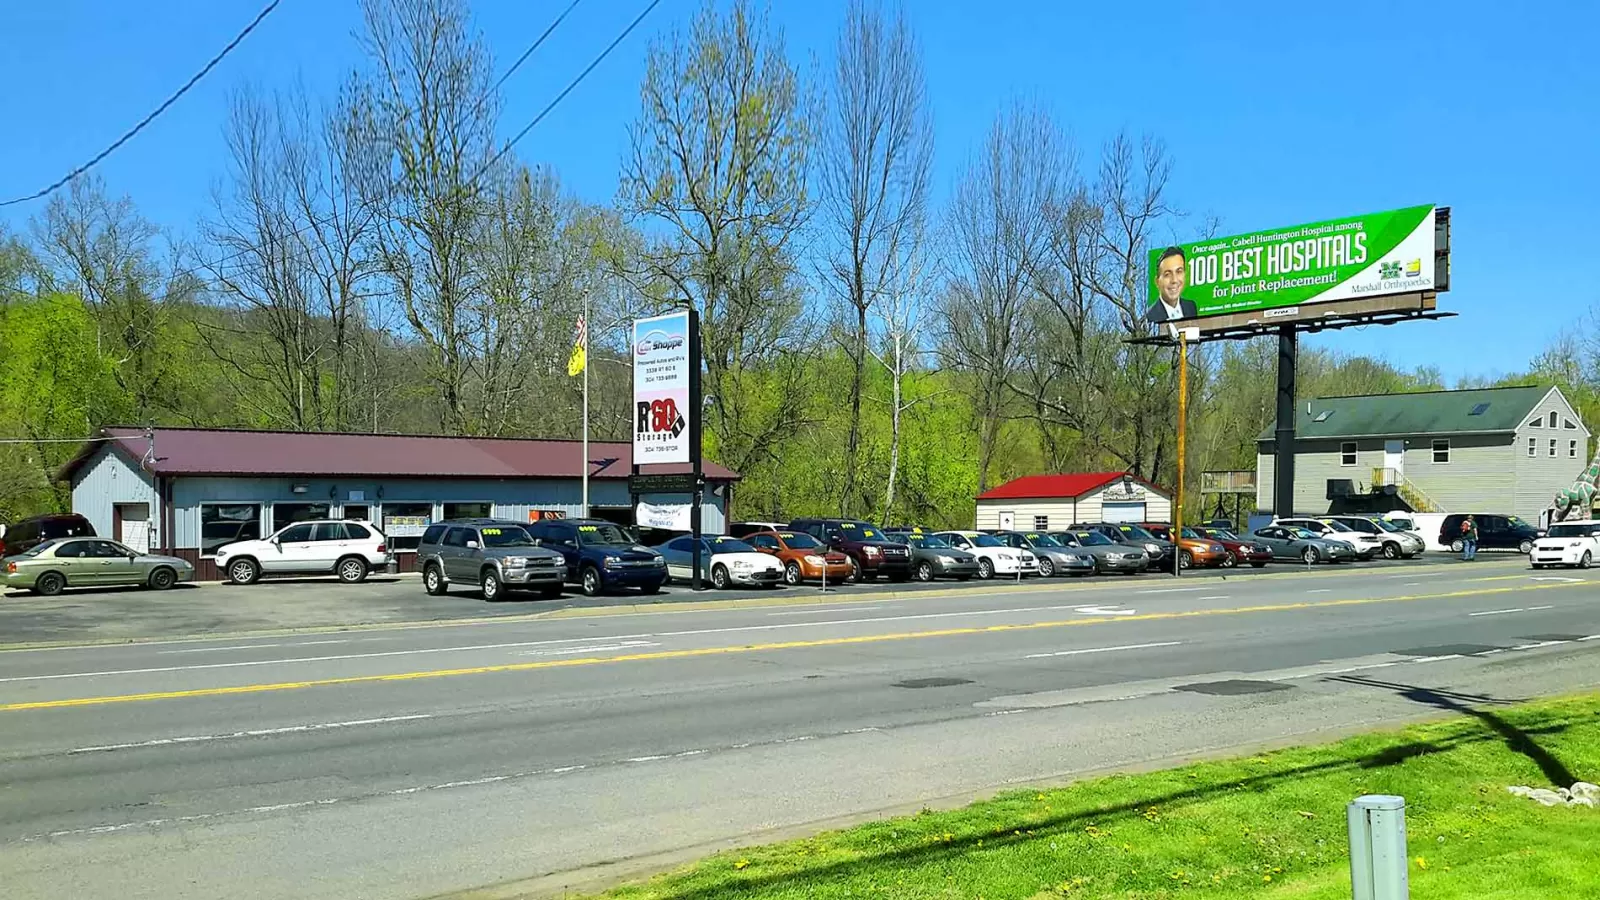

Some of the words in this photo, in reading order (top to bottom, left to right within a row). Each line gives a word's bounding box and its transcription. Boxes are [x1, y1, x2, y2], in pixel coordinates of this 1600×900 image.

[1192, 245, 1208, 254] Once
[1232, 236, 1256, 247] Cabell
[1256, 230, 1300, 243] Huntington
[1301, 223, 1334, 237] Hospital
[1335, 220, 1363, 231] among
[1188, 254, 1218, 287] 100
[1222, 246, 1264, 282] BEST
[1267, 231, 1367, 276] HOSPITALS
[1212, 285, 1228, 298] for
[1230, 282, 1256, 298] Joint
[1259, 269, 1337, 294] Replacement!
[1352, 280, 1382, 294] Marshall
[1384, 276, 1432, 290] Orthopaedics
[637, 433, 673, 442] Storage
